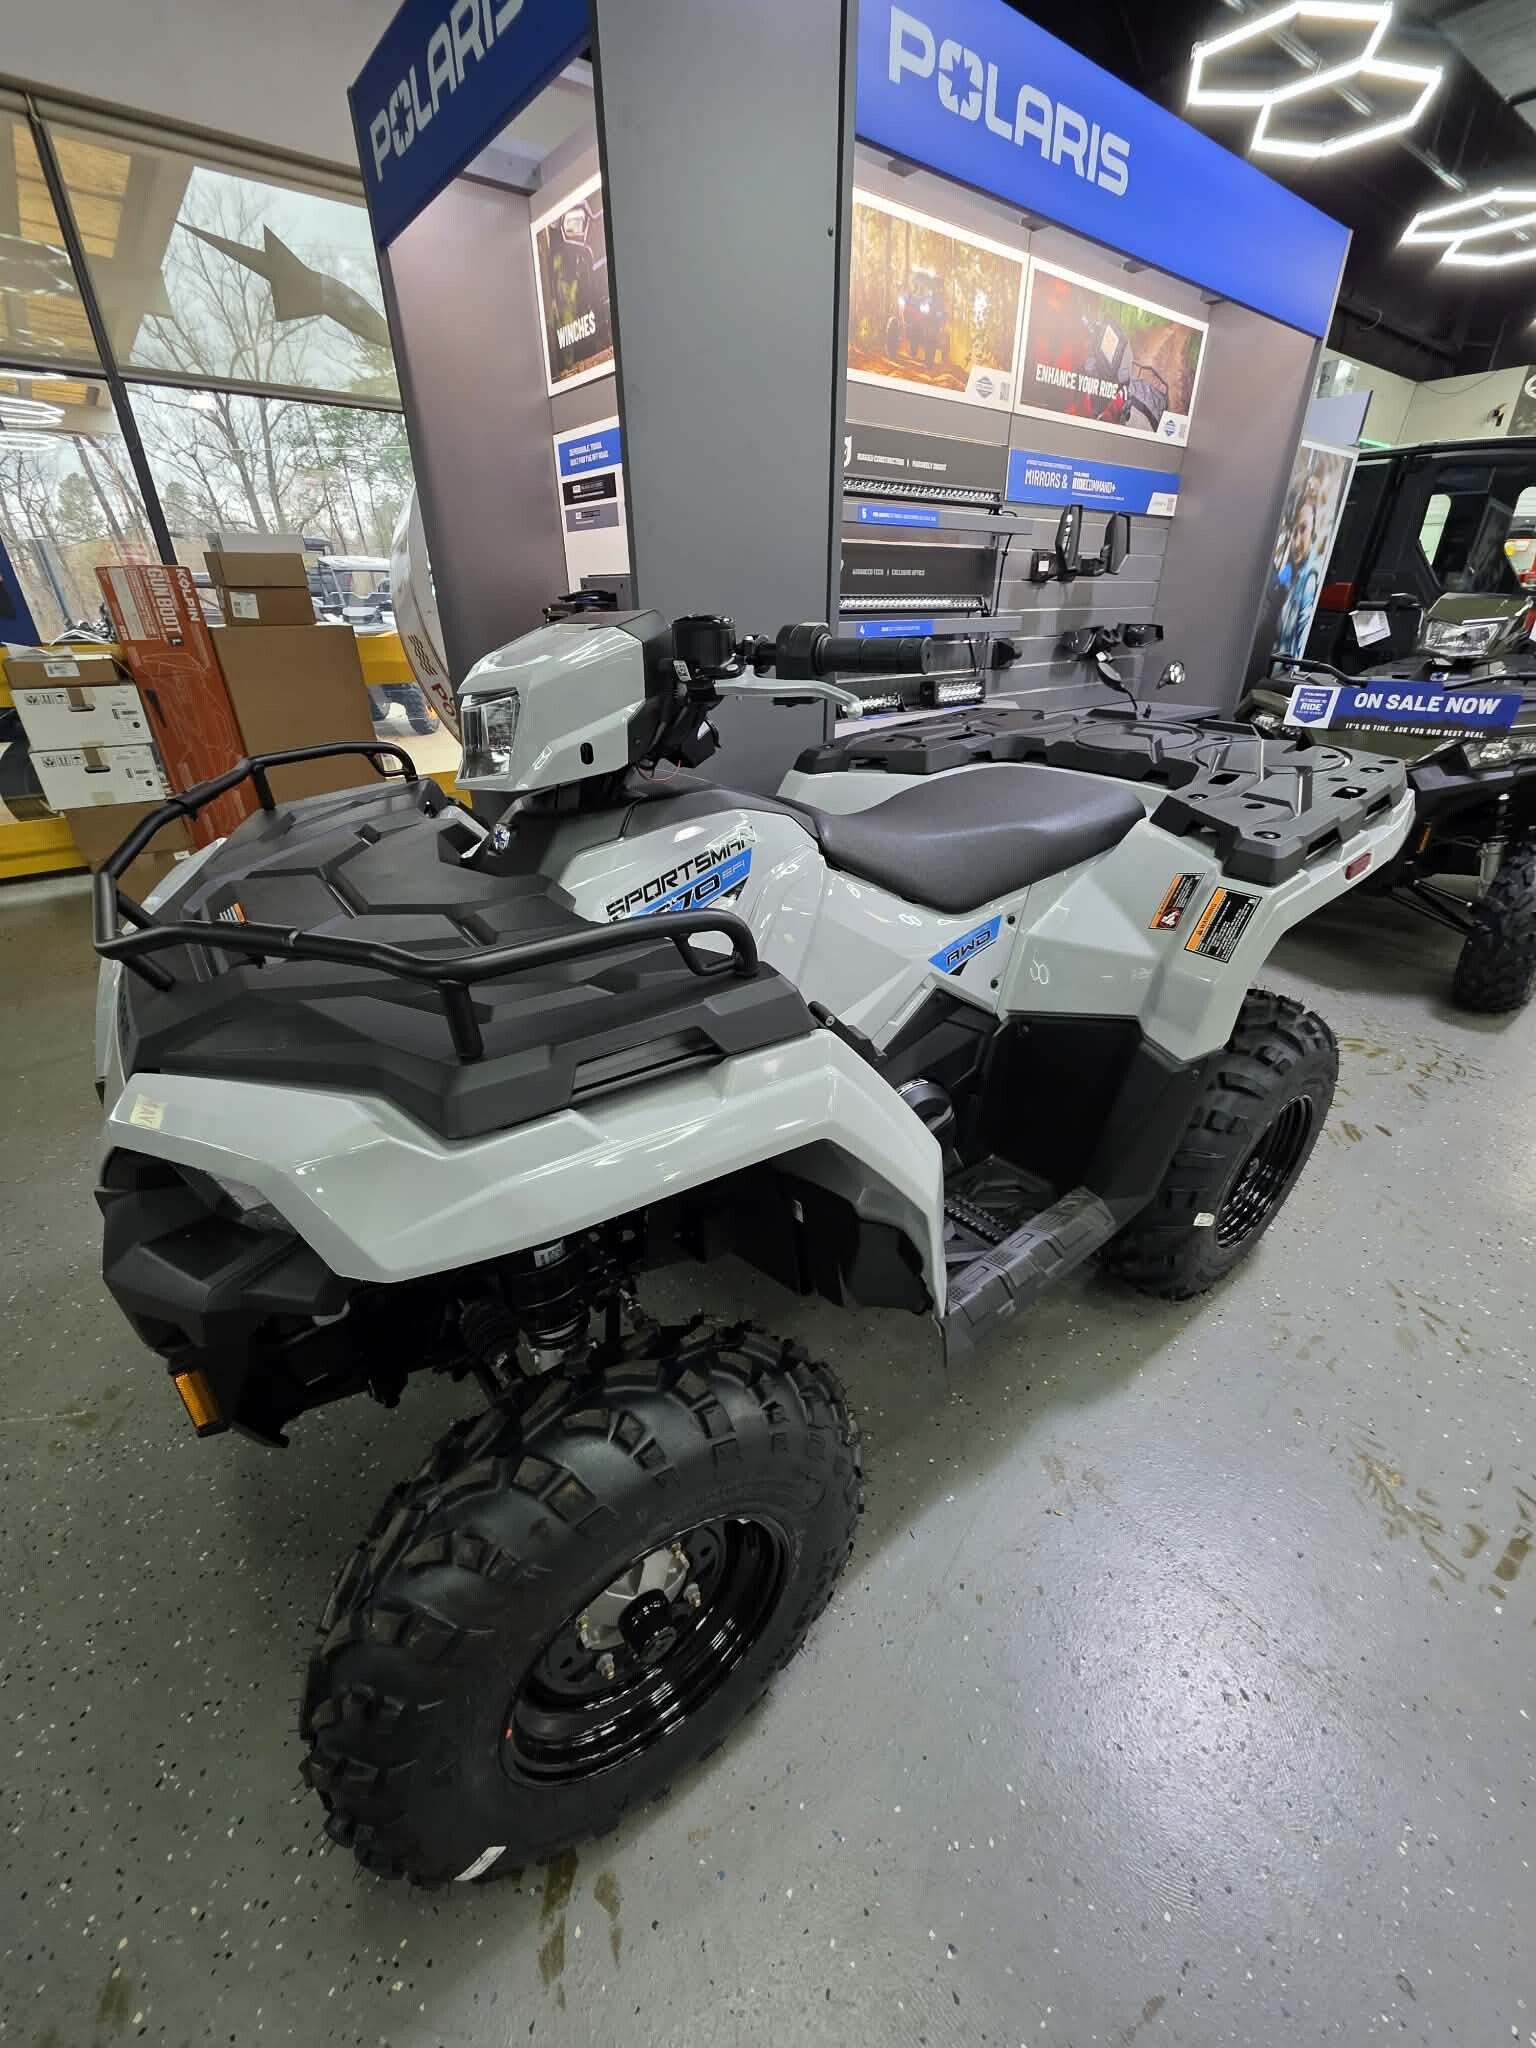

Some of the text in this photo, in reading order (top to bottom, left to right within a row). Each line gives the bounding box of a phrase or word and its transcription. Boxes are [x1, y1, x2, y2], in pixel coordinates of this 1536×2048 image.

[888, 6, 1131, 196] POLARIS
[557, 310, 596, 349] WINCHES
[1036, 363, 1118, 399] ENHANCE YOUR RIDE
[1024, 469, 1062, 488] MIRRORS
[1061, 475, 1068, 489] &
[176, 568, 200, 622] KOLPIN
[1300, 702, 1322, 711] RIDE
[1354, 692, 1502, 715] ON SALE NOW
[1345, 722, 1360, 730] IT'S
[1410, 727, 1425, 735] FOR
[1443, 729, 1463, 737] BEST
[947, 928, 991, 966] AWD
